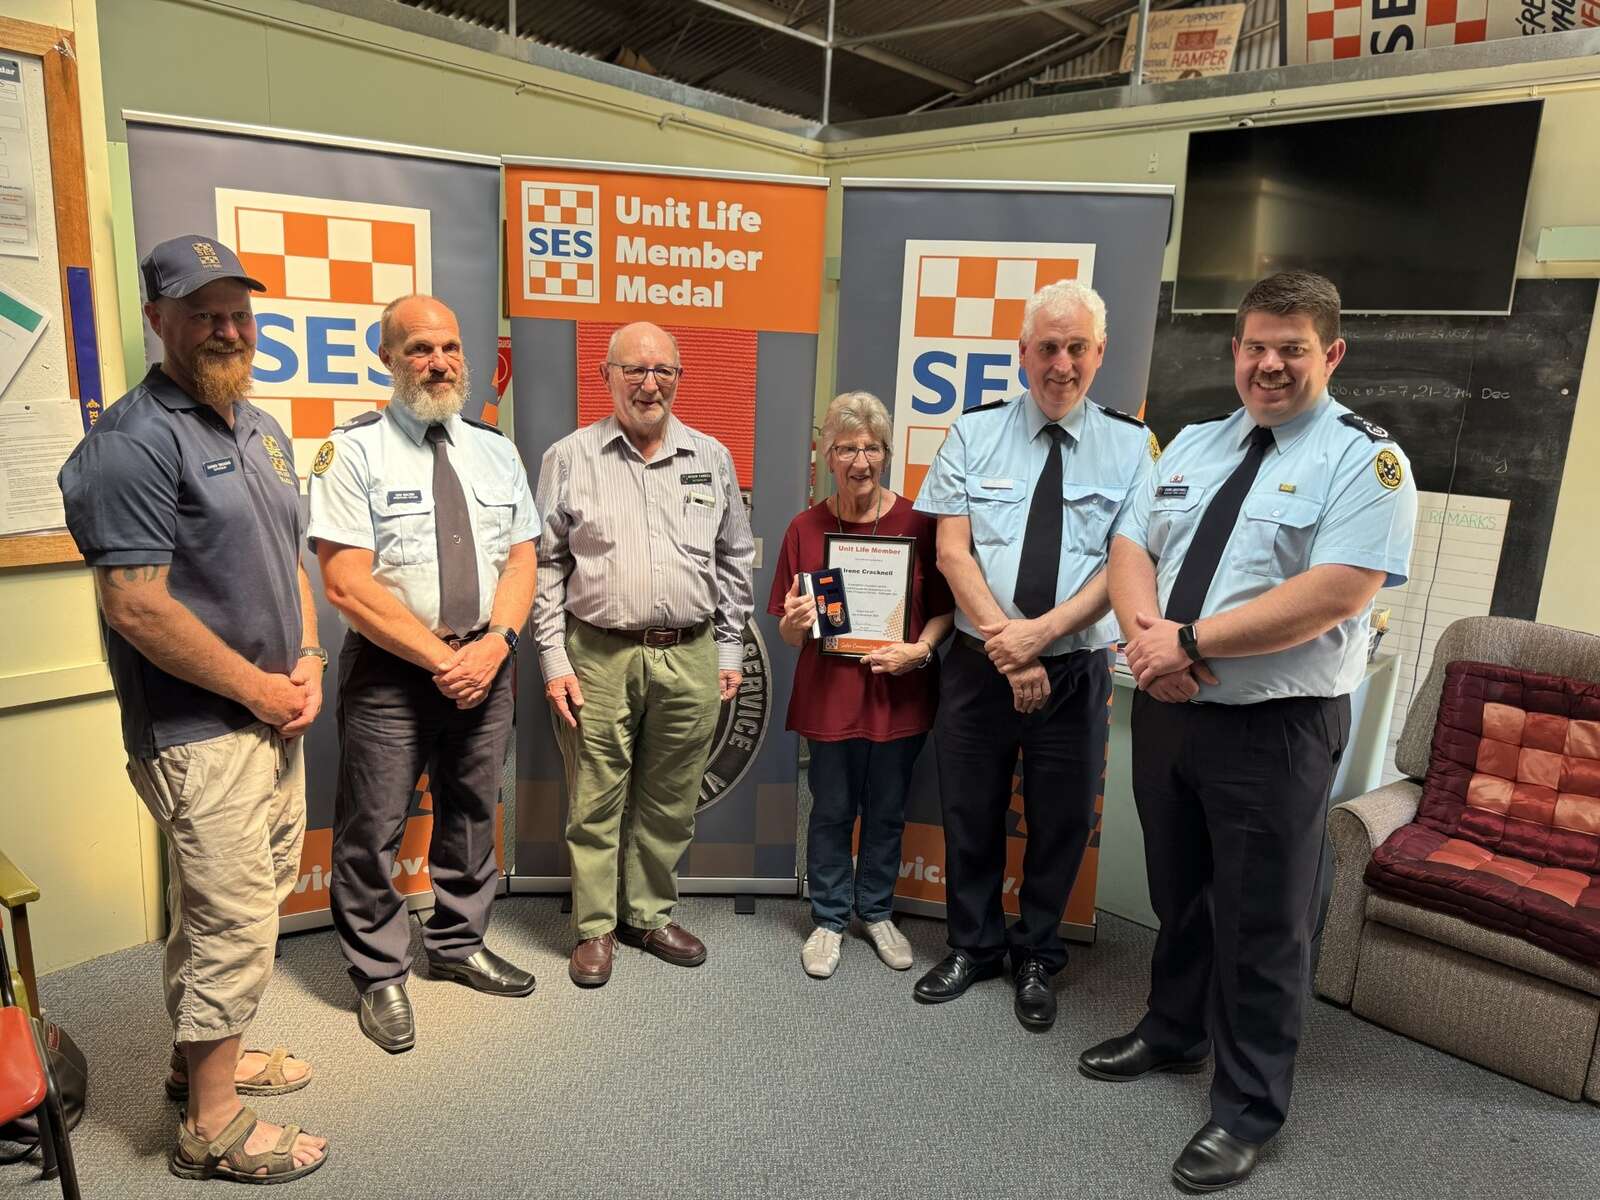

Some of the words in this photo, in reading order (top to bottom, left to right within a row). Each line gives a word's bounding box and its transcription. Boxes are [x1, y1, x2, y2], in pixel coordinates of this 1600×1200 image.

[1178, 11, 1227, 24] SUPPORT
[1171, 50, 1229, 68] HAMPER
[615, 195, 691, 229] Unit
[698, 200, 762, 233] Life
[528, 227, 593, 258] SES
[615, 235, 763, 272] Member
[615, 275, 724, 308] Medal
[911, 350, 1030, 415] SE
[1481, 387, 1511, 400] Dec
[838, 545, 854, 553] Unit
[855, 546, 870, 554] Life
[871, 547, 902, 556] Member
[843, 567, 860, 575] Irene
[861, 568, 894, 577] Cracknell
[728, 642, 764, 751] SERVICE
